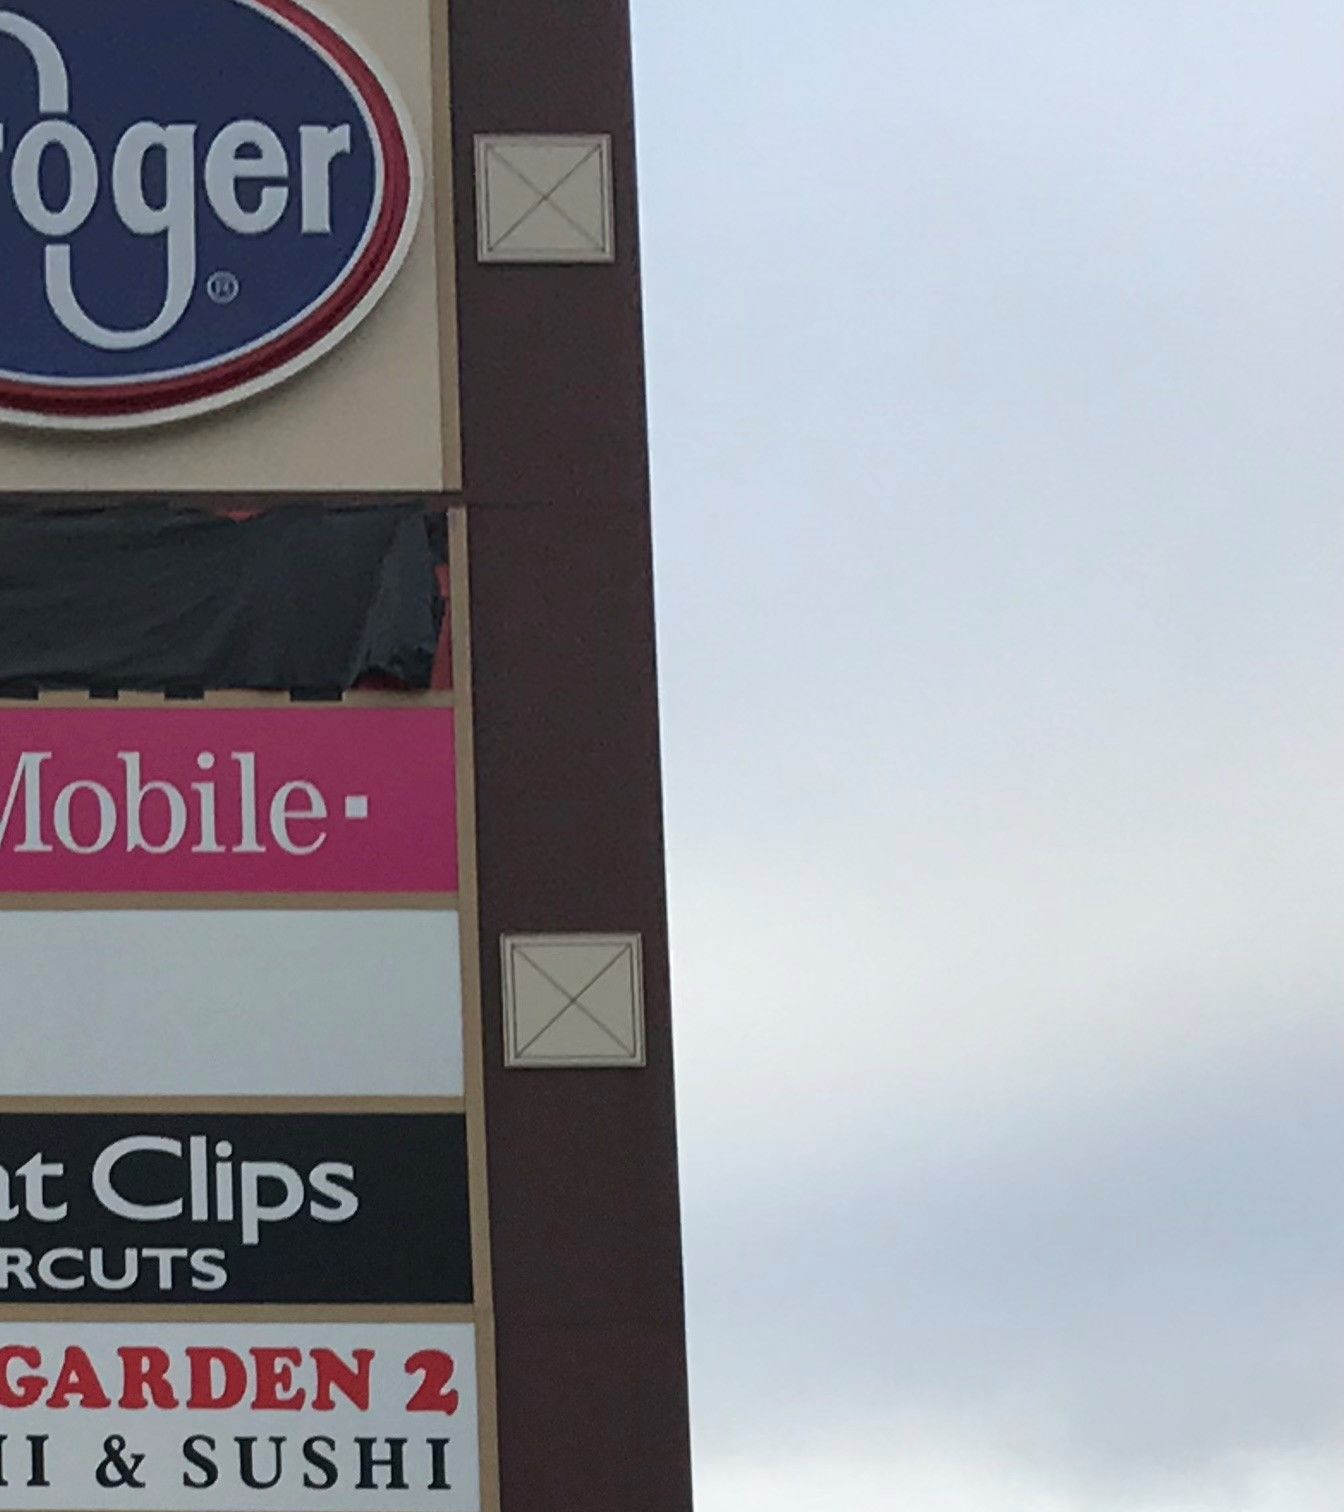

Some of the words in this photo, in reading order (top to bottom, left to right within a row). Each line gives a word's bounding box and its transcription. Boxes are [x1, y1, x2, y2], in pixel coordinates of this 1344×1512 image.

[92, 1136, 359, 1245] Clips
[404, 1349, 458, 1416] 2
[96, 1435, 145, 1488] &
[183, 1435, 451, 1490] SUSHI
